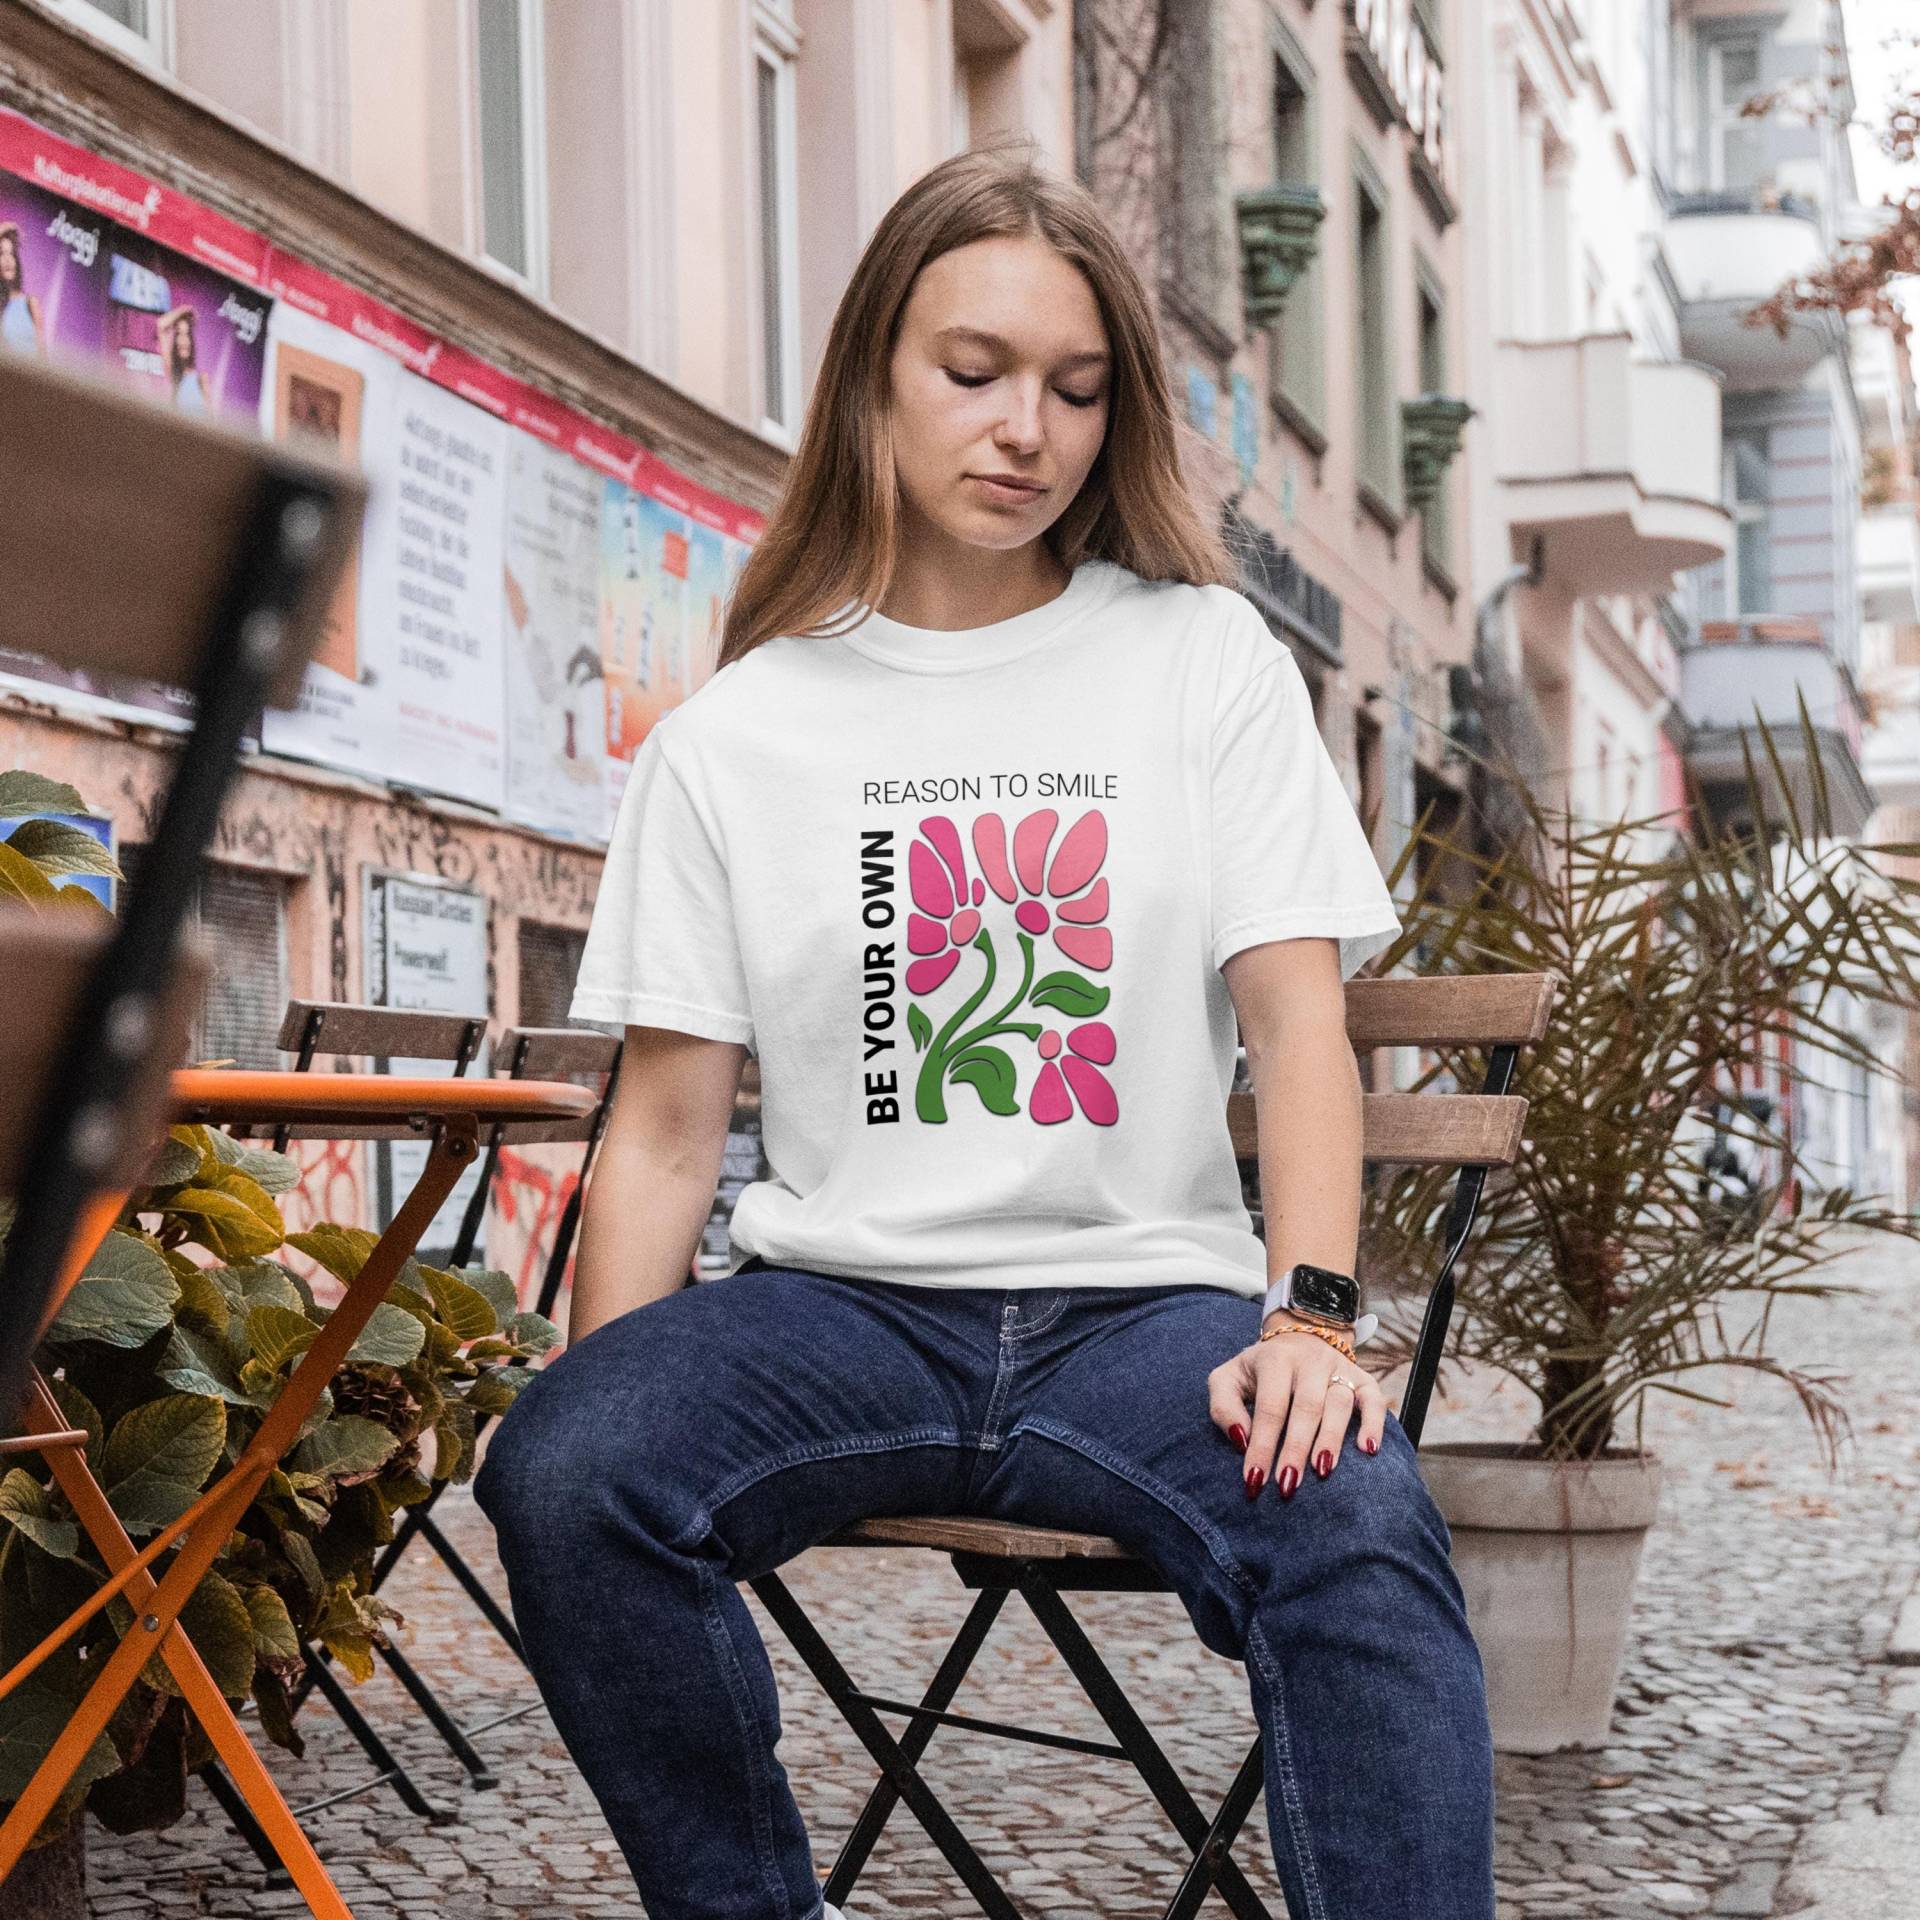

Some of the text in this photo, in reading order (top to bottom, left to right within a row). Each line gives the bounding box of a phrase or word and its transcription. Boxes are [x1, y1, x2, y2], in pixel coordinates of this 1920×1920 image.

[864, 773, 1118, 805] REASON TO SMILE
[860, 830, 900, 1126] BE YOUR OWN
